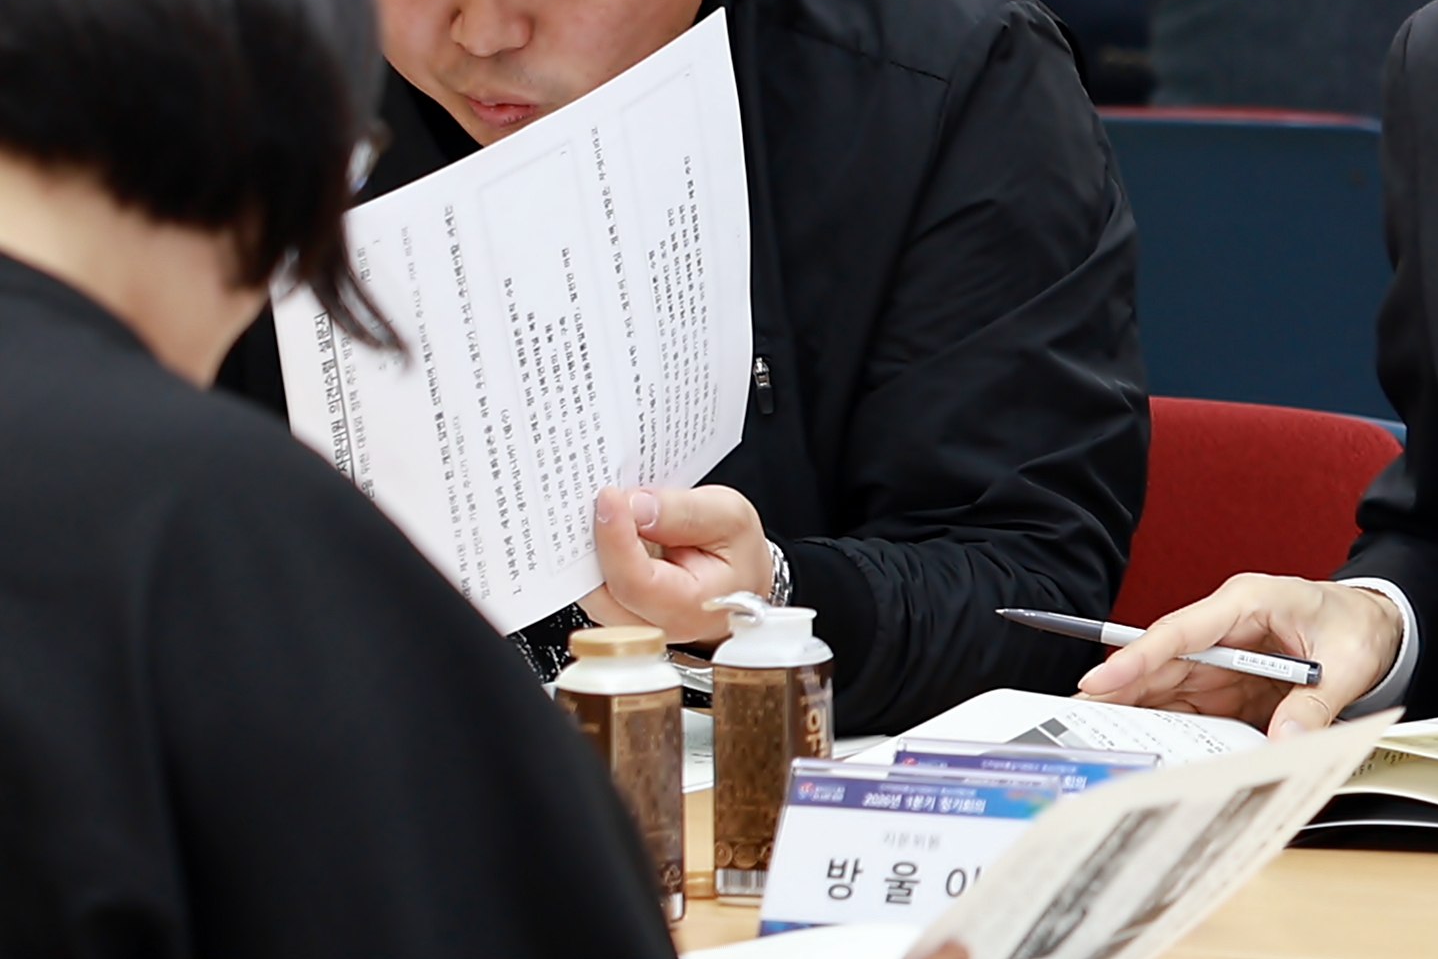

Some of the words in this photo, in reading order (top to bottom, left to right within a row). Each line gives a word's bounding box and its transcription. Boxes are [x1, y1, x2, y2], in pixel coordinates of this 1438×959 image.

[312, 309, 334, 355] 설문지
[319, 355, 344, 416] 의견수렴
[328, 415, 353, 476] 자문위원
